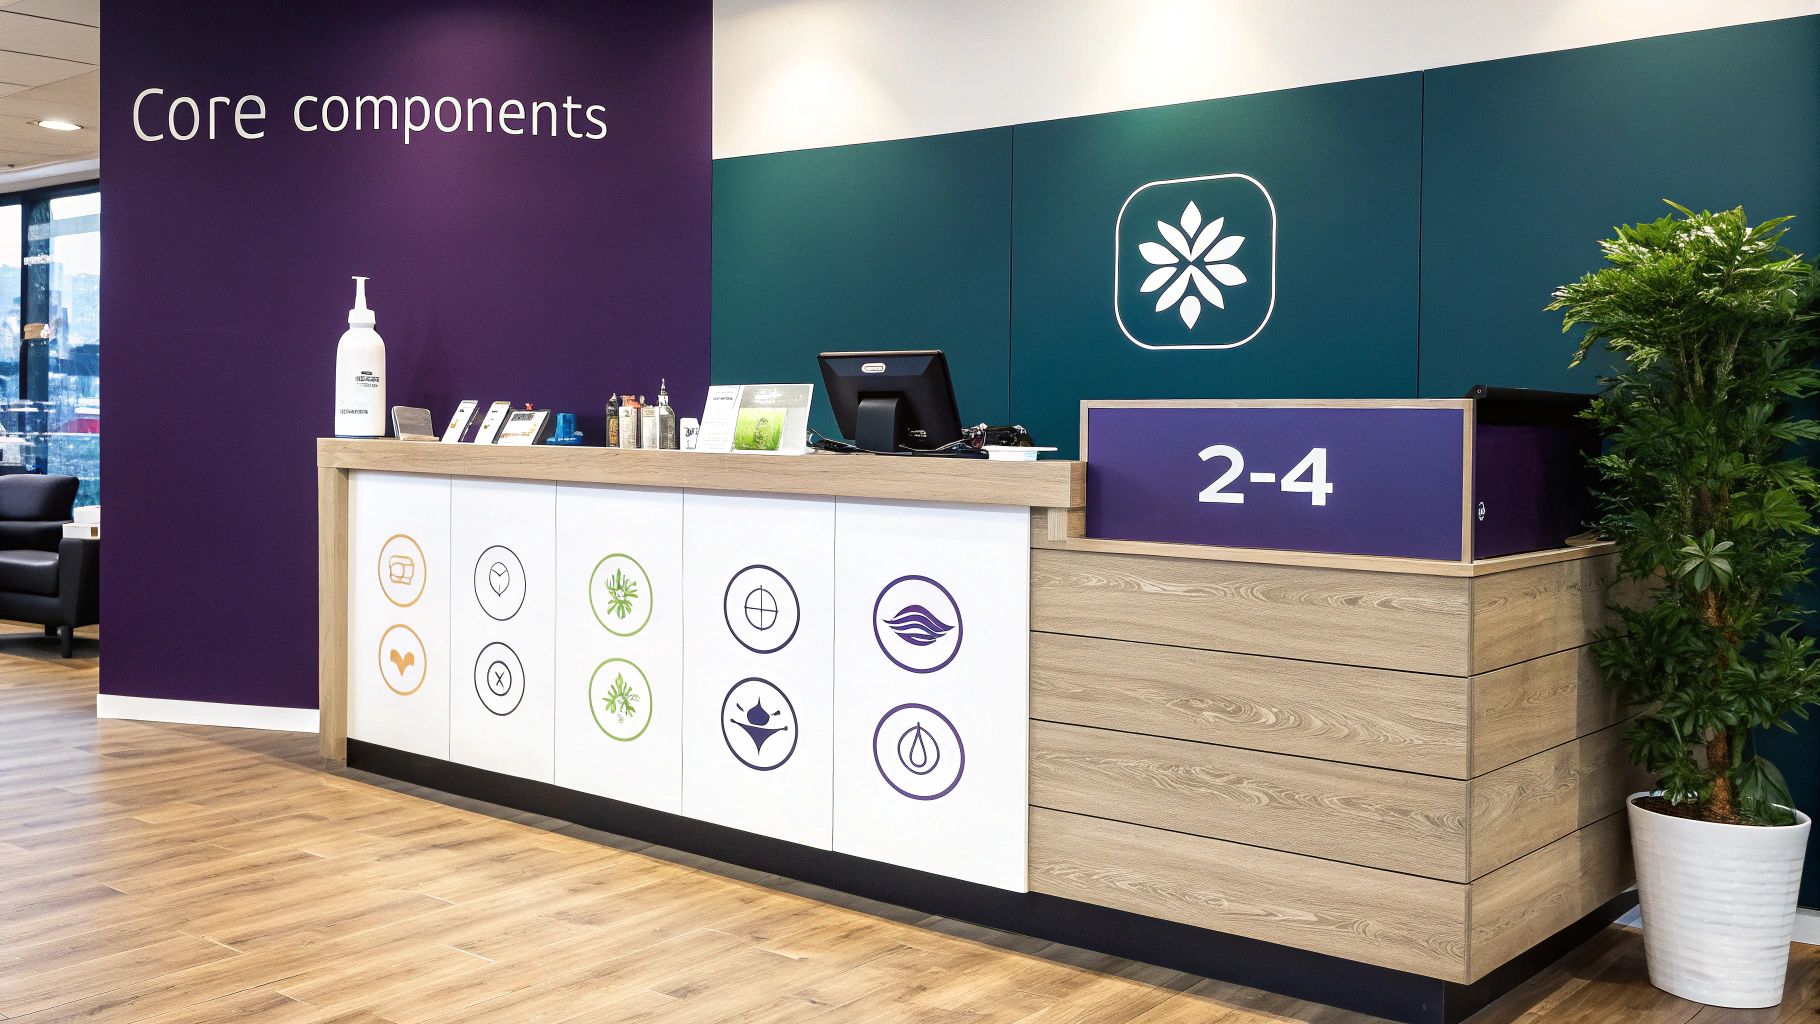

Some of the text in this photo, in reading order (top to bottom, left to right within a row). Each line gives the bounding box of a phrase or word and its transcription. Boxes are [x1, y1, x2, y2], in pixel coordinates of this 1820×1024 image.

[132, 87, 608, 145] Core components
[1197, 444, 1335, 507] 2-4
